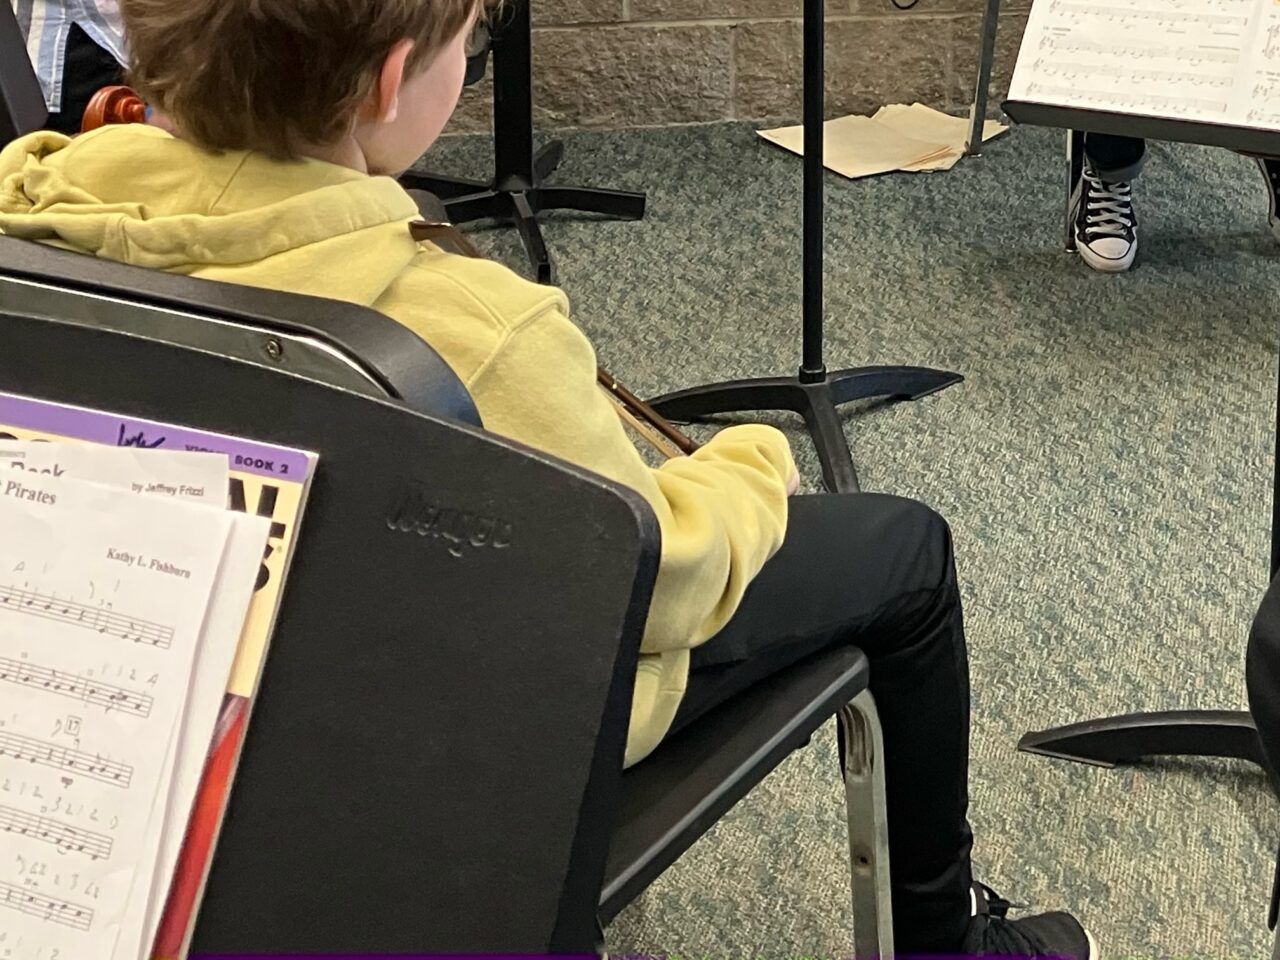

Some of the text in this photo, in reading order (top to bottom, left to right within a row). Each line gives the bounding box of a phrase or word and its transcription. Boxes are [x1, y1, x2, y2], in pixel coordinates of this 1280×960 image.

[234, 454, 289, 474] BOOK 2
[6, 479, 57, 507] Pirates
[132, 481, 142, 493] by
[144, 482, 178, 497] Jeffrey
[106, 547, 192, 580] Kathy L. Fishburn
